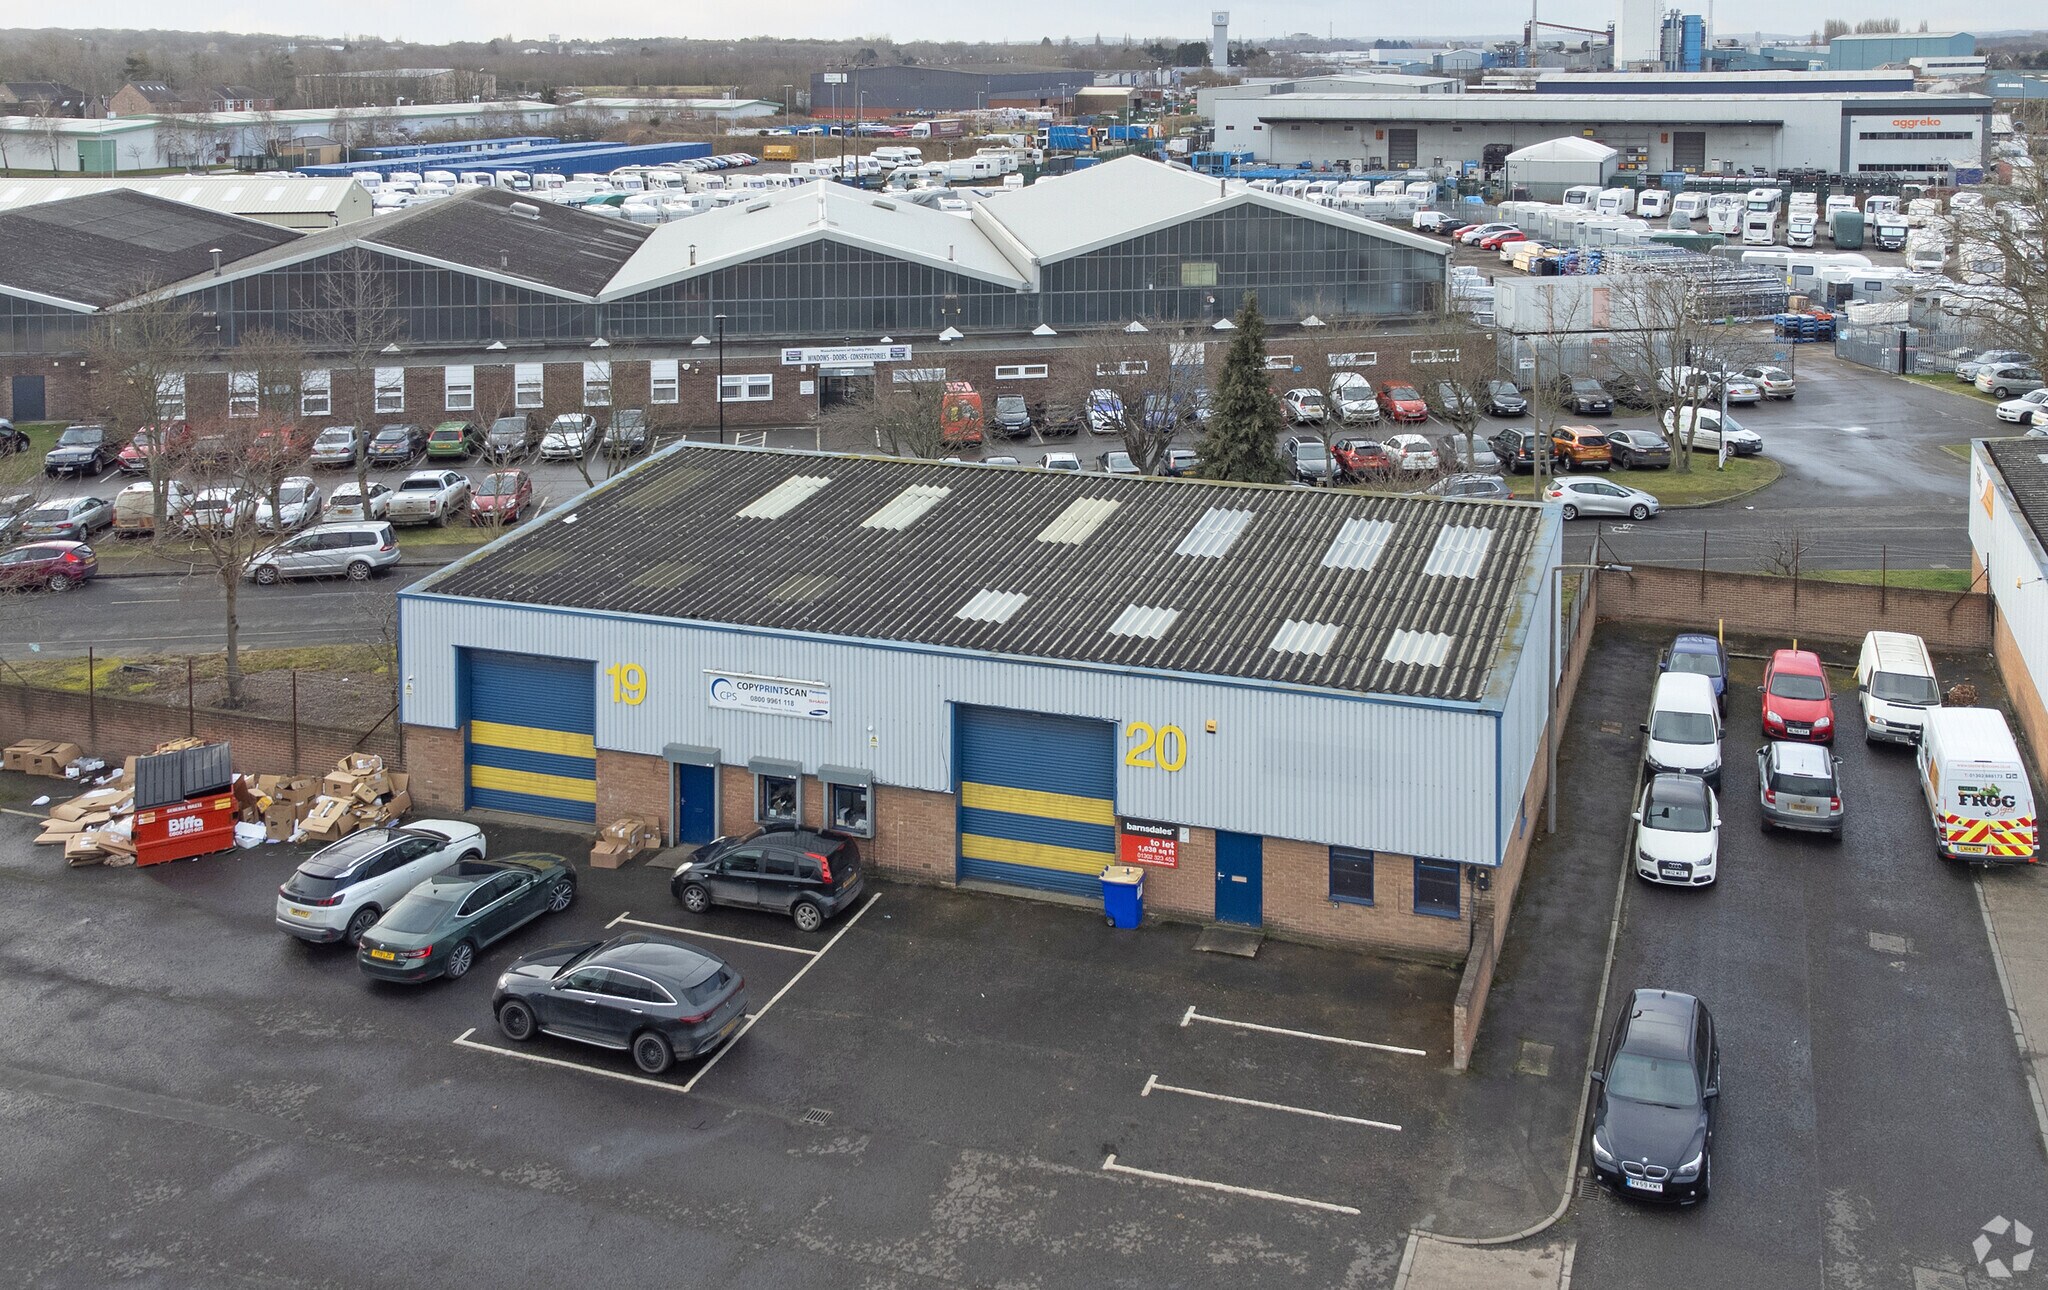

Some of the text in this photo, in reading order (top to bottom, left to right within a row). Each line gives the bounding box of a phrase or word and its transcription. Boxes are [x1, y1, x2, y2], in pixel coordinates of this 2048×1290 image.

[1892, 117, 1941, 129] aggreko
[807, 354, 830, 362] WINDOWS
[832, 353, 847, 361] DOORS
[850, 352, 886, 361] CONSERVATORIES
[605, 662, 647, 705] 19
[736, 681, 807, 697] COPYPRINTSCAN
[720, 690, 738, 702] CPS
[750, 695, 795, 707] 0800 9961 118
[1125, 721, 1187, 772] 20
[1958, 794, 2015, 807] FROG
[168, 815, 204, 832] Biffa
[1126, 822, 1172, 835] barnsdales
[1150, 839, 1175, 849] to let
